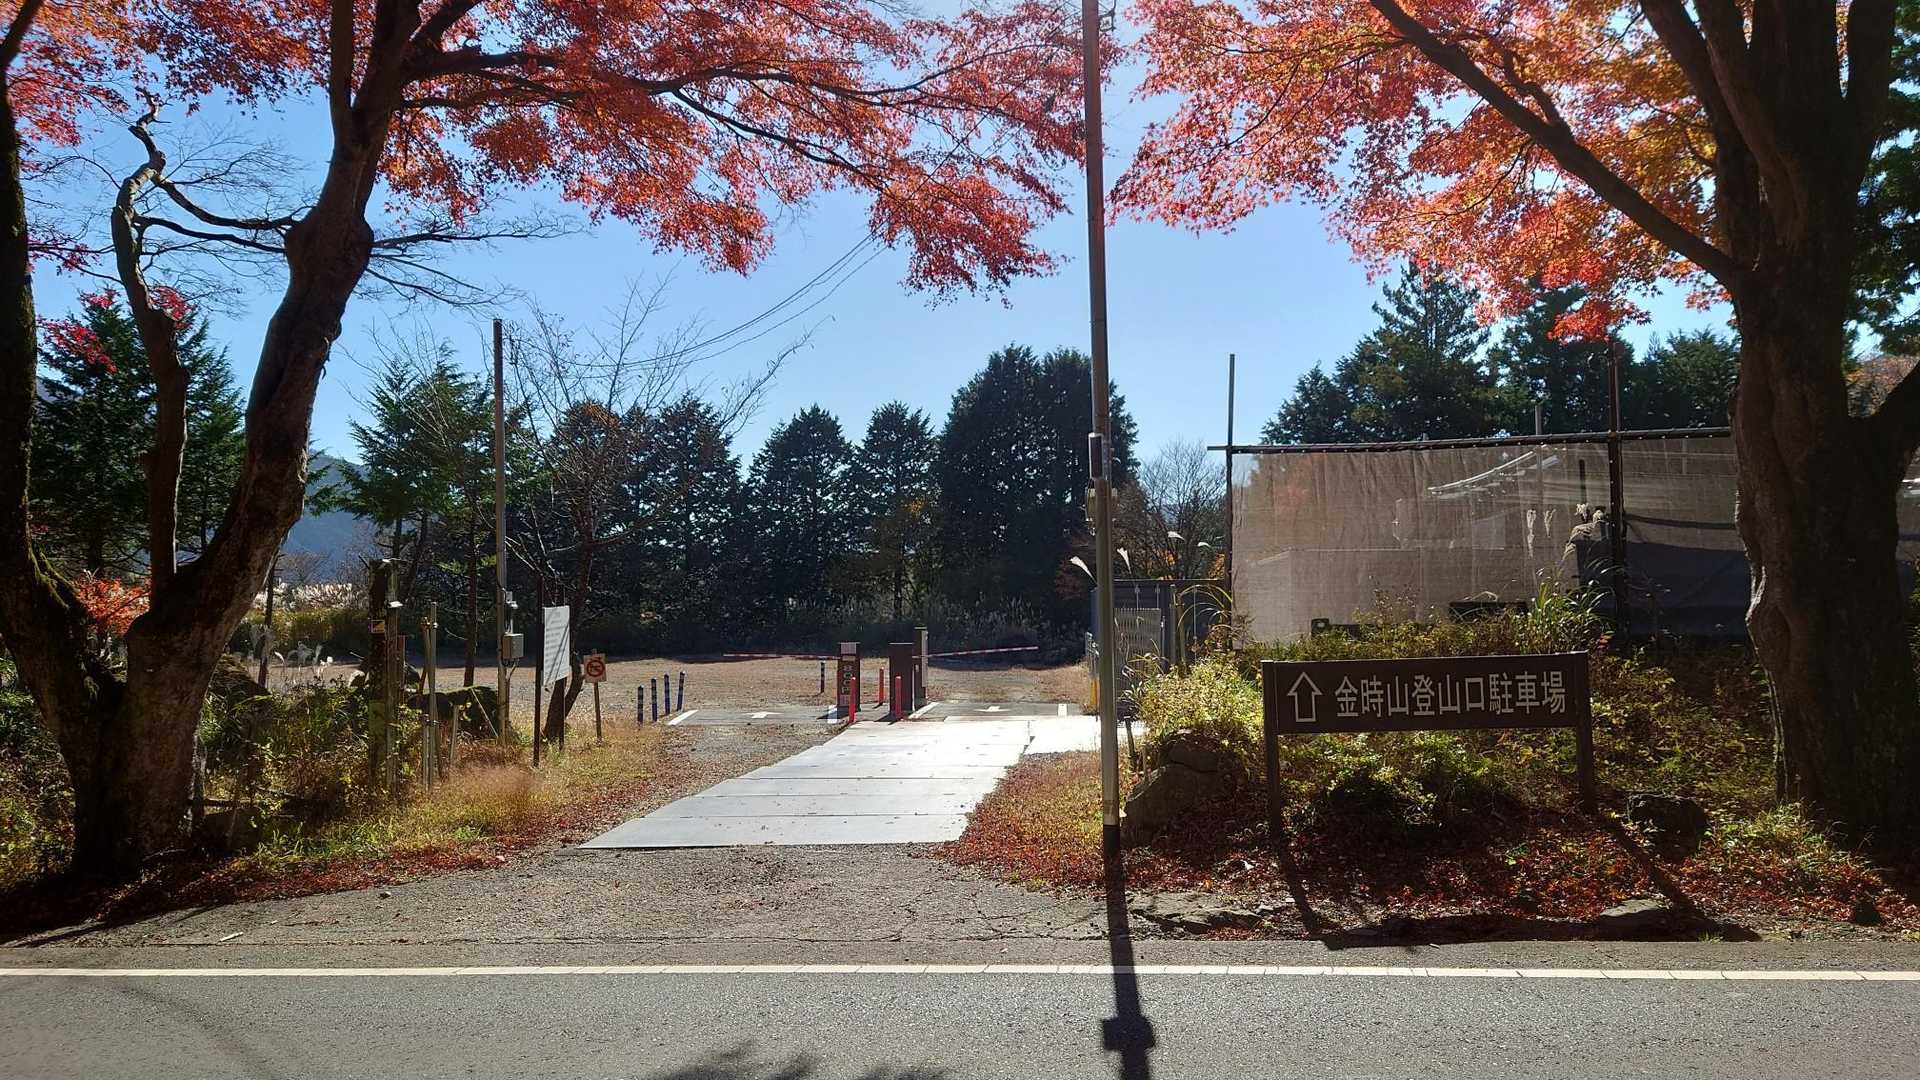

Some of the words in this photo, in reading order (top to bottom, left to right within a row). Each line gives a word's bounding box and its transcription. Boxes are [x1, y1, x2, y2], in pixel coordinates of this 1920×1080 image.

[1335, 671, 1566, 717] 金時山登山口駐車場
